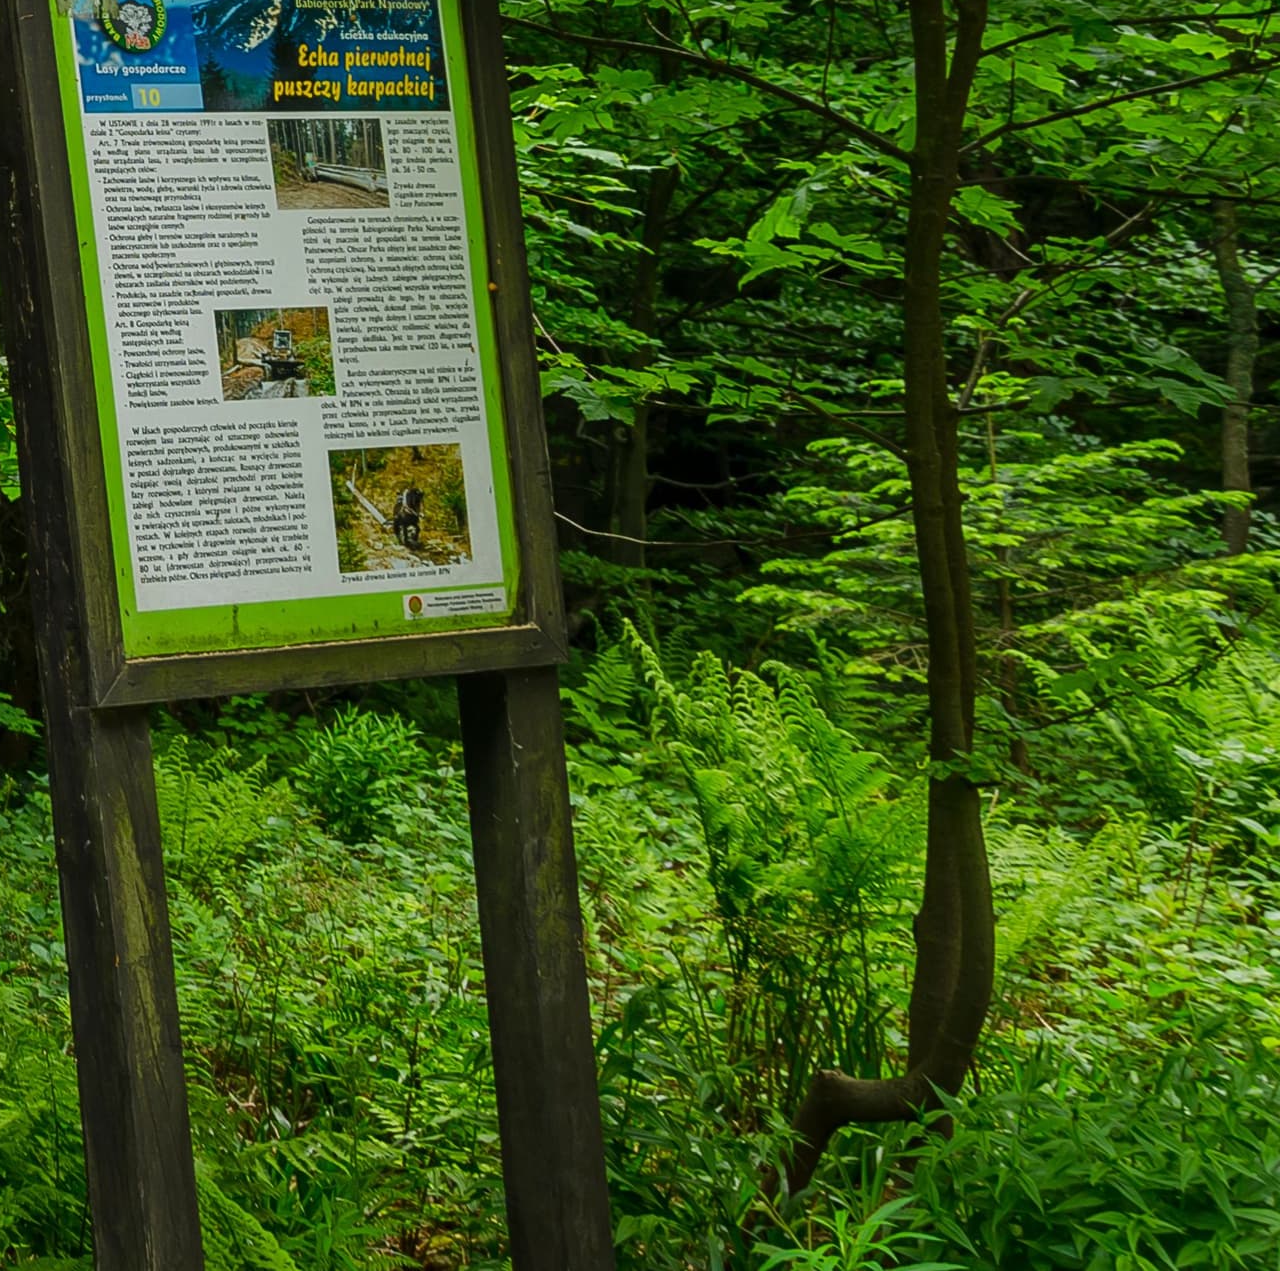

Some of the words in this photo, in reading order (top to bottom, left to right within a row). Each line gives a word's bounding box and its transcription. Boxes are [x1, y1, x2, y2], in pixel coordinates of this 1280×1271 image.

[378, 0, 427, 11] Narodowy
[340, 30, 375, 41] ścieżka
[376, 30, 429, 43] edukacyjna
[298, 43, 339, 67] Echa
[345, 45, 431, 72] pierwotnej
[95, 63, 119, 77] Lasy
[122, 63, 187, 77] gospodarcze
[273, 79, 341, 103] puszczy
[347, 73, 435, 102] karpackiej
[86, 93, 129, 104] przystanek
[139, 88, 161, 107] 10
[148, 328, 159, 338] się
